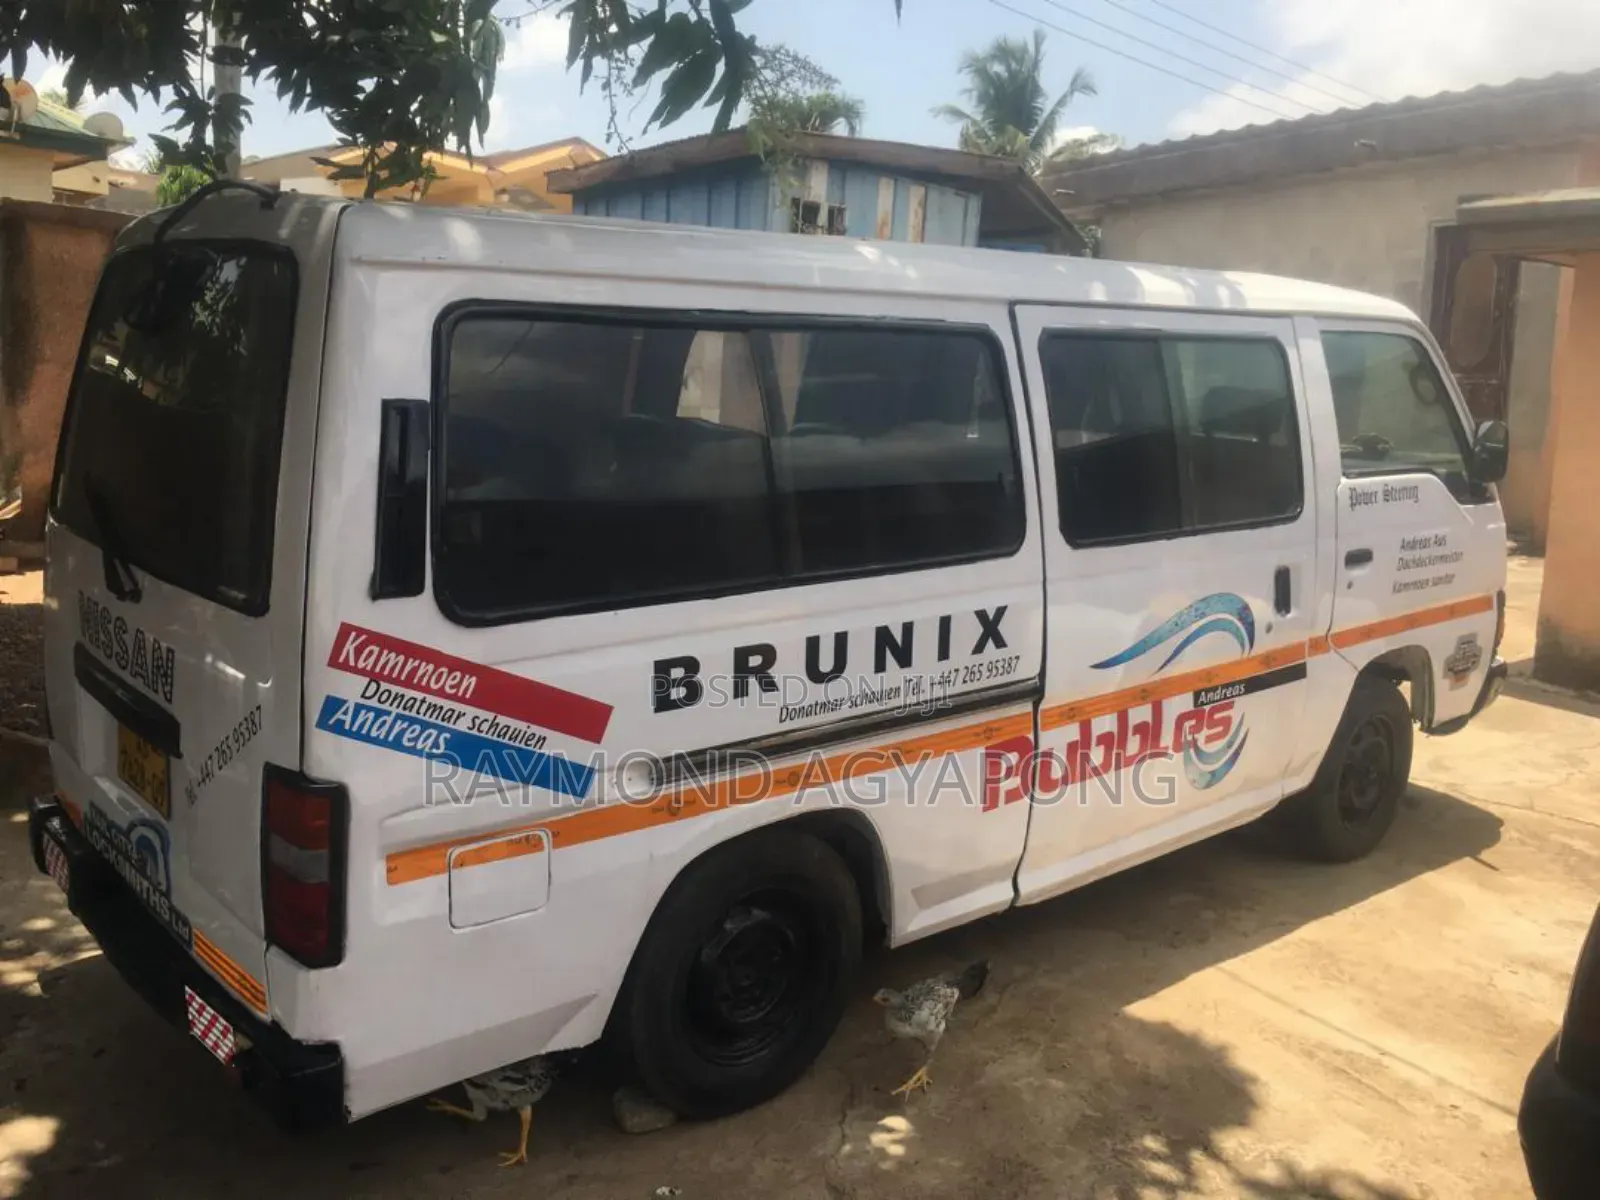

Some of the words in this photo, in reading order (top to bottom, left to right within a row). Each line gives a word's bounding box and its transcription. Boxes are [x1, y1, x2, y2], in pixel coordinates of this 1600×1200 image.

[1349, 486, 1379, 512] Power
[78, 587, 176, 705] NISSAN
[653, 605, 1009, 713] BRUNIX
[361, 679, 466, 727] Donatmar
[467, 715, 548, 750] schauien
[778, 699, 845, 724] Donatmar
[962, 663, 984, 684] 265
[986, 655, 1021, 680] 95387
[1198, 682, 1246, 705] Andreas
[215, 735, 233, 771] 265
[232, 704, 263, 753] 95387
[328, 702, 451, 754] Andreas
[171, 913, 190, 941] Ltd
